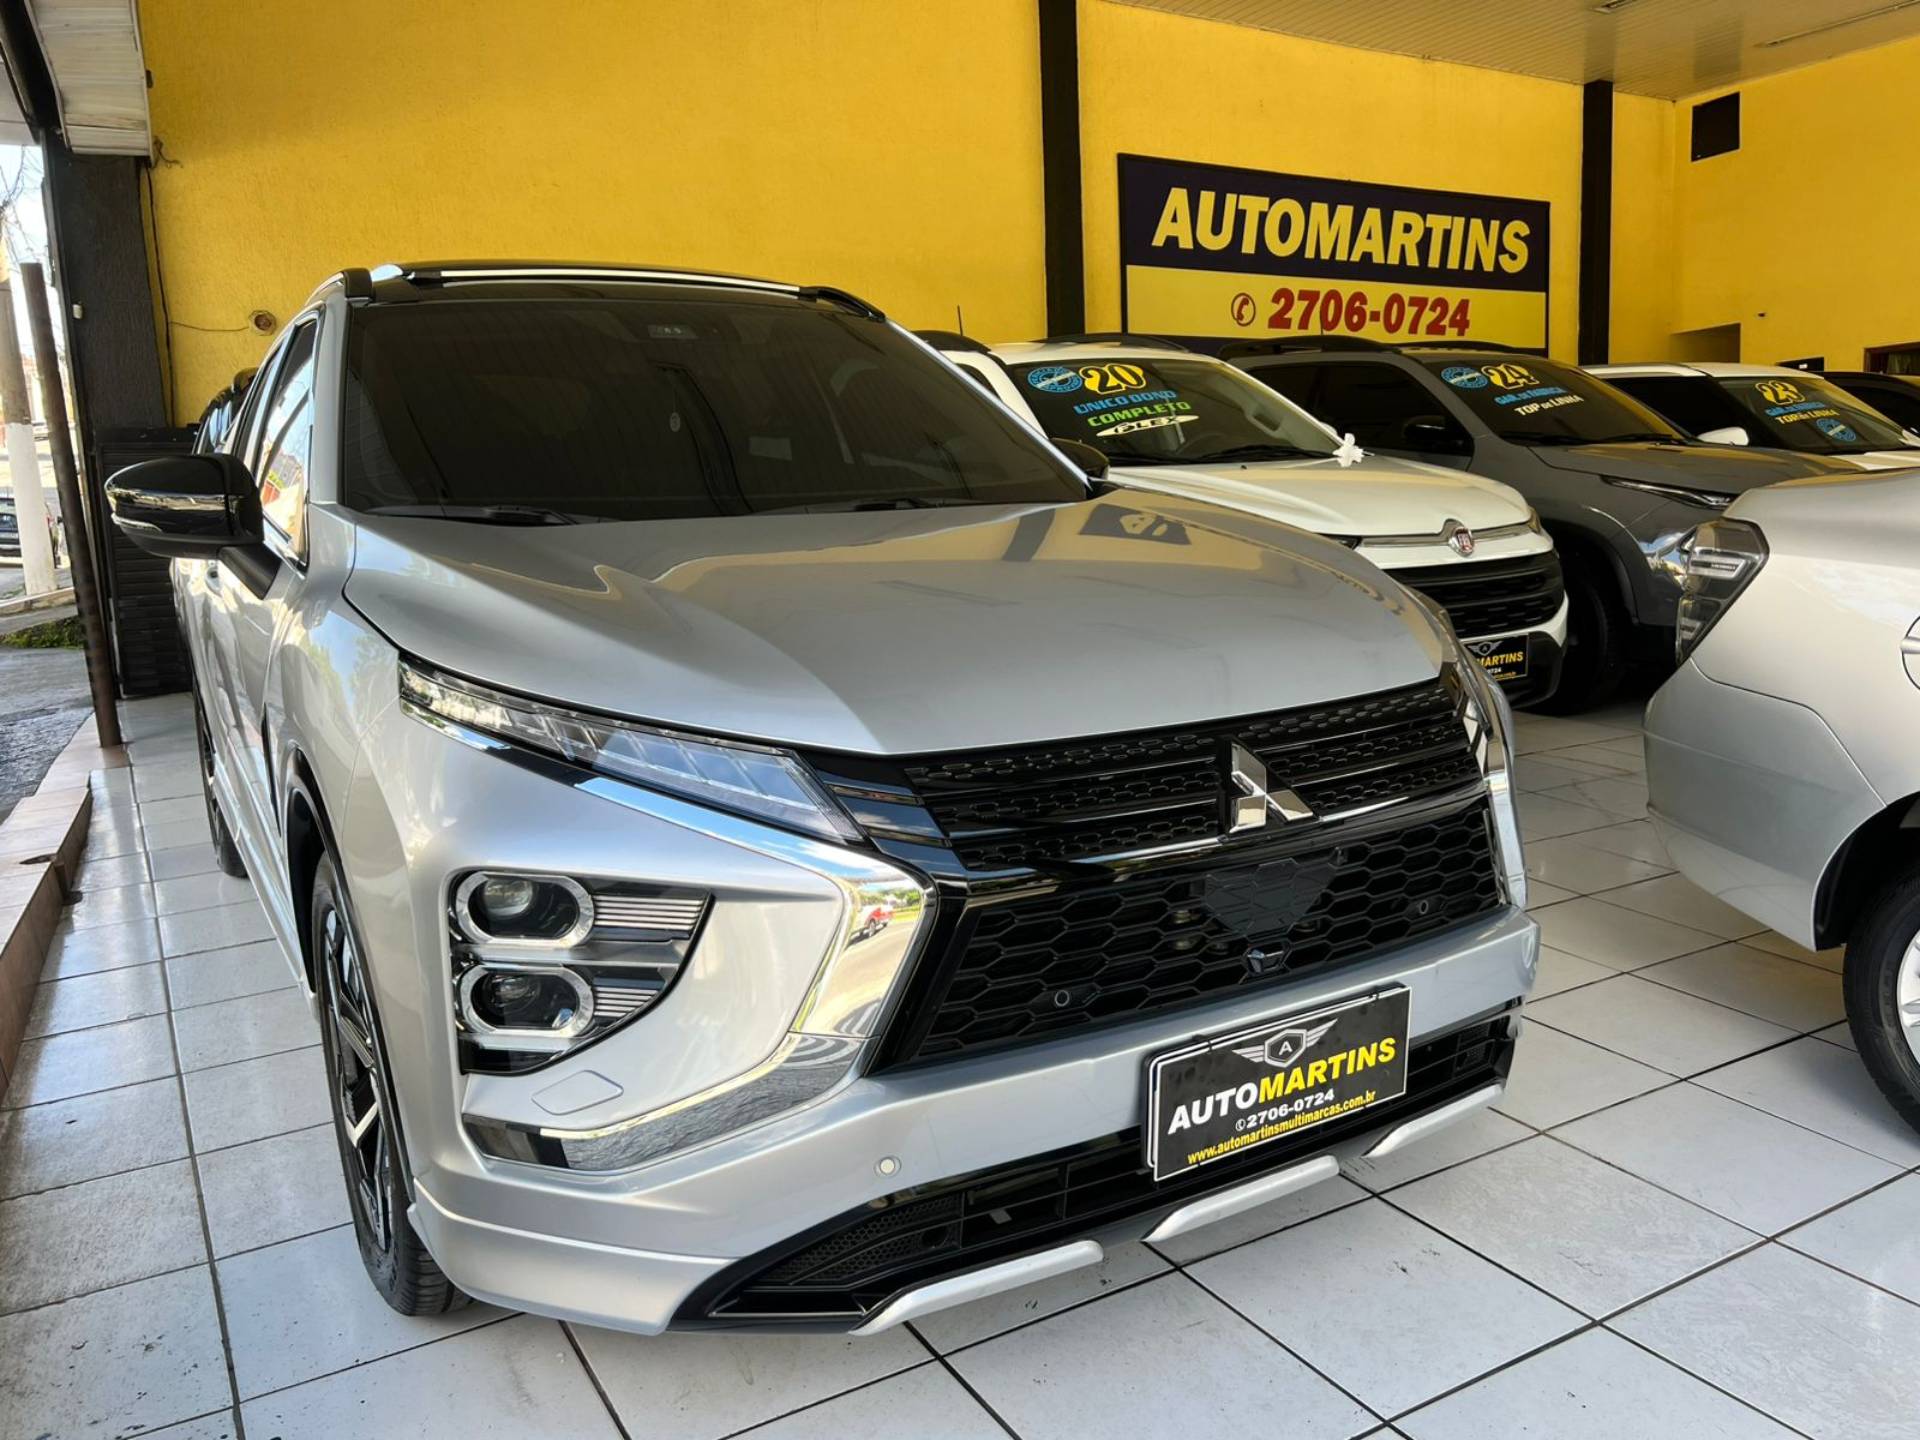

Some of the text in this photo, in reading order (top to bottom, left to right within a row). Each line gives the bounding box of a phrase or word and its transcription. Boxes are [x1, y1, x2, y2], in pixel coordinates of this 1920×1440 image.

[1151, 186, 1531, 274] AUTOMARTINS
[1267, 286, 1471, 337] 2706-0724
[1079, 363, 1147, 395] 20
[1481, 363, 1541, 390] 24
[1087, 401, 1192, 427] COMPLETO
[1513, 402, 1540, 416] TOP
[1477, 651, 1524, 667] MARTINS
[1278, 1040, 1294, 1056] A
[1167, 1037, 1397, 1136] AUTOMARTINS
[1246, 1088, 1336, 1129] 2706-0724
[1187, 1089, 1377, 1165] www.automartinsmultimarcas.com.br
